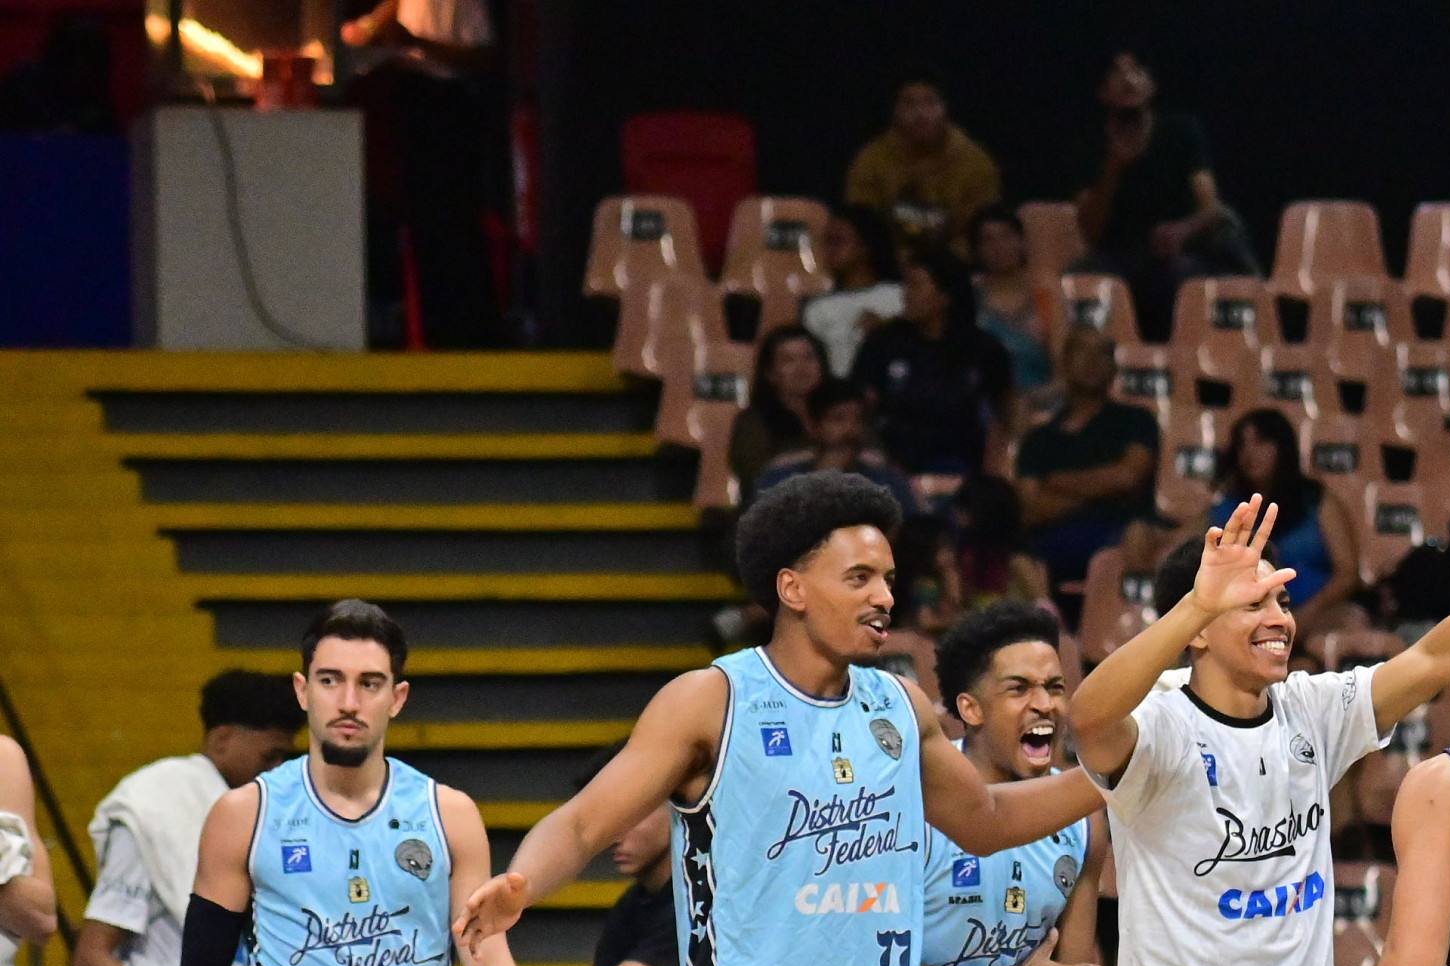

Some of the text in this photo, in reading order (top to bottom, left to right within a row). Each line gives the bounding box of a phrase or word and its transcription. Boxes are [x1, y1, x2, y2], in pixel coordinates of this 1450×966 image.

[767, 785, 896, 860] Distrito
[814, 812, 919, 876] Federal
[1217, 871, 1326, 920] CAIXA
[289, 904, 410, 966] Distrito
